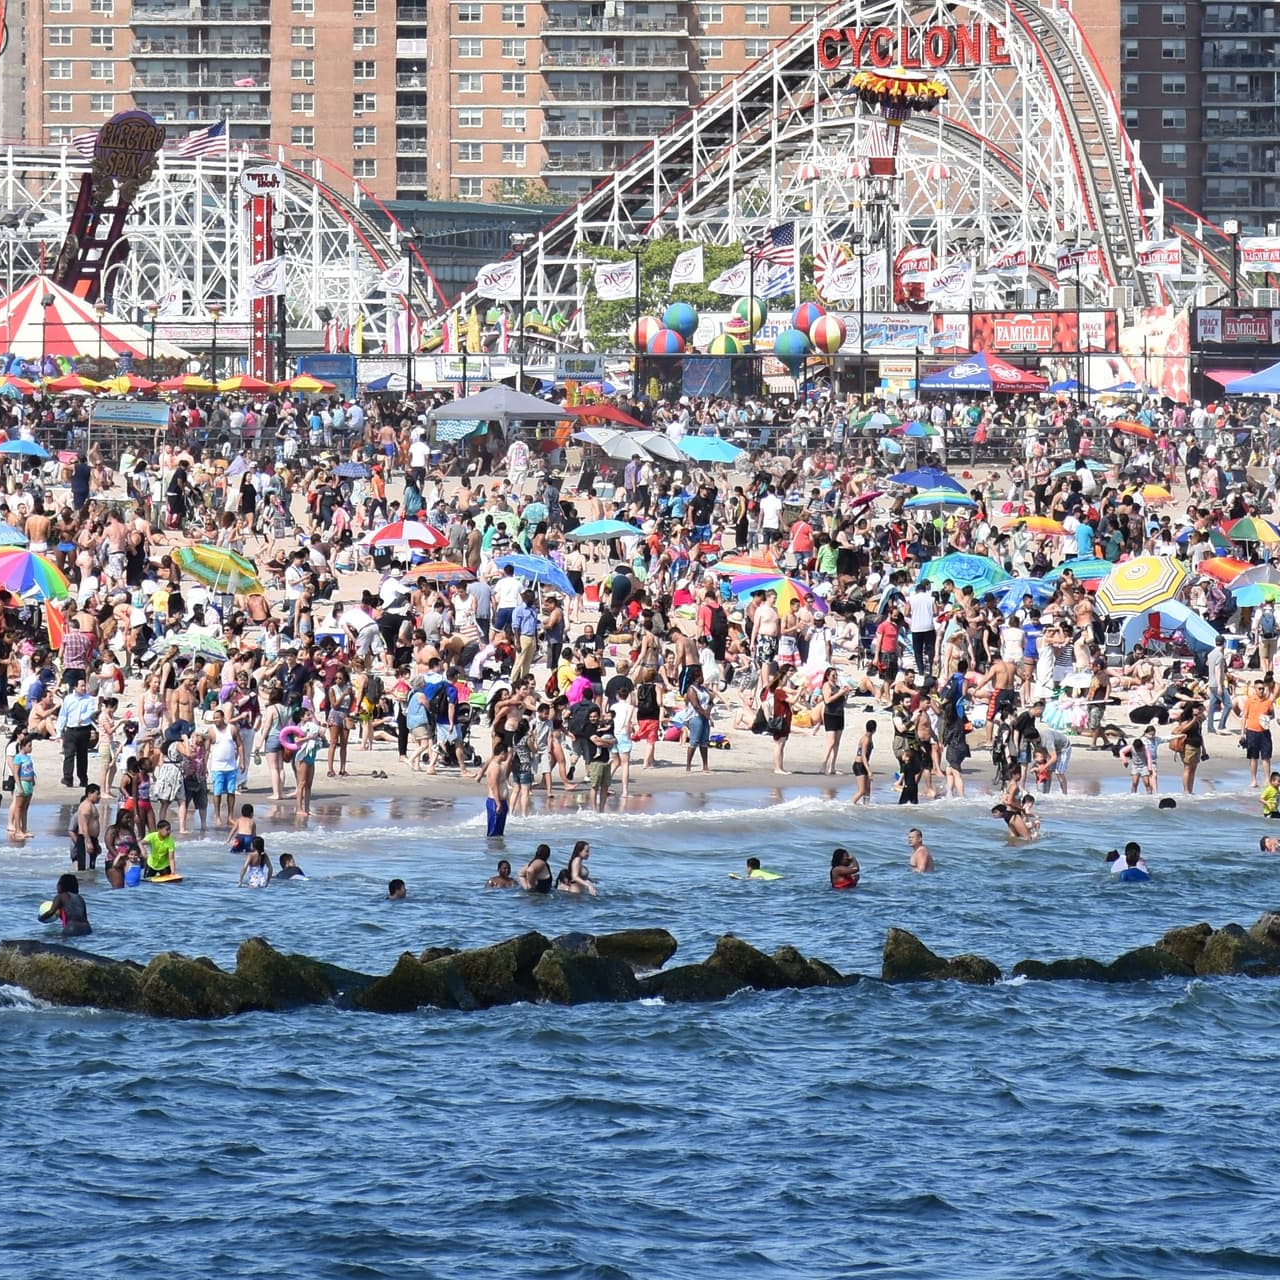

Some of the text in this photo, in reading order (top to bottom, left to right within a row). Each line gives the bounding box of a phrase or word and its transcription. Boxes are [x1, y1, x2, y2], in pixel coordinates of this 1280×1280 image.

[817, 24, 1012, 68] CYCLONE
[102, 124, 166, 152] ELECTRO
[107, 151, 140, 178] SPIN
[247, 173, 269, 181] TWIST
[1082, 323, 1102, 331] SNACK
[1200, 319, 1218, 327] SNACK
[1226, 323, 1266, 336] FAMIGLIA
[996, 325, 1050, 342] FAMIGLIA
